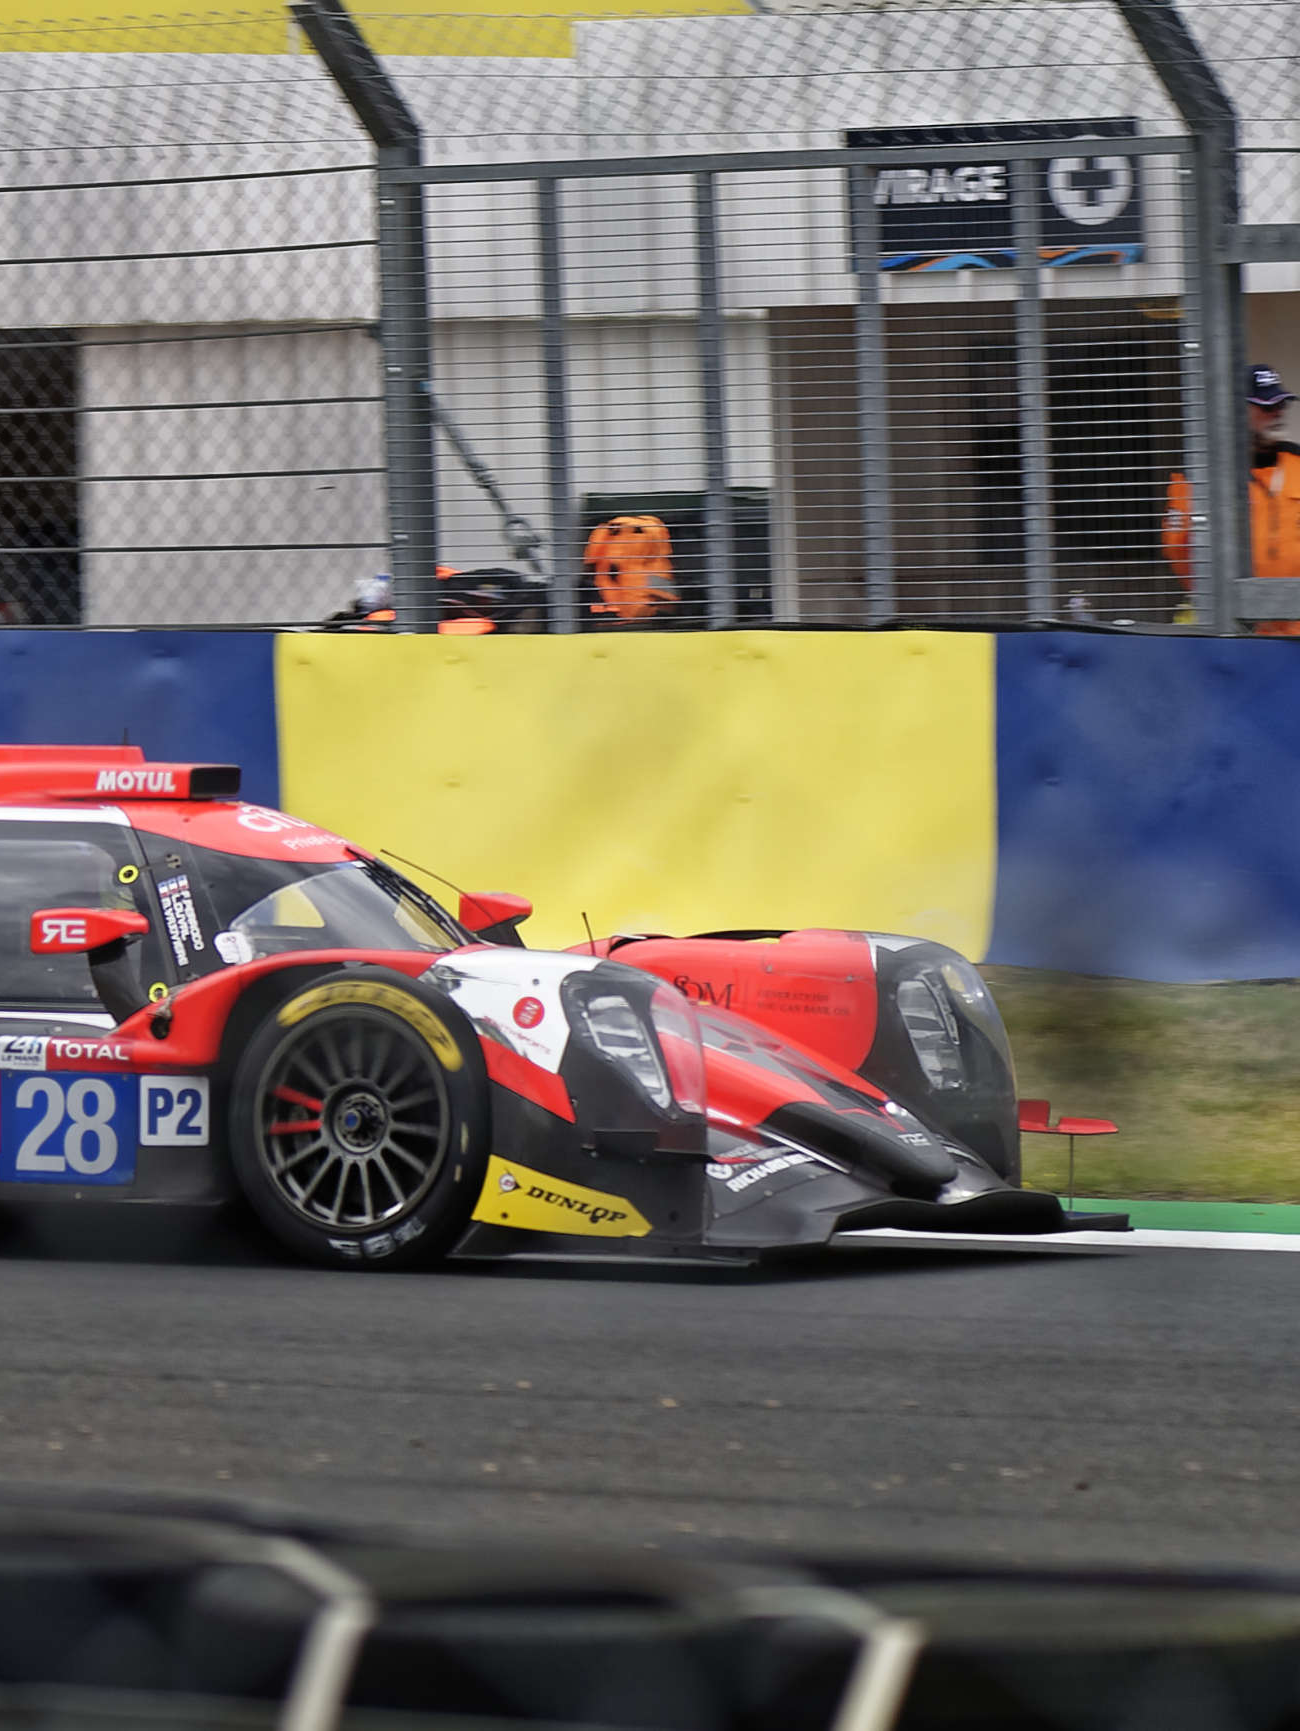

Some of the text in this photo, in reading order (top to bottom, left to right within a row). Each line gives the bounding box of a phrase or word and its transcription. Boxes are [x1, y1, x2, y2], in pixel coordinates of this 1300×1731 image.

[96, 770, 177, 793] MOTUL
[51, 1039, 130, 1061] TOTAL
[15, 1076, 119, 1175] 28
[147, 1087, 203, 1136] P2
[526, 1186, 629, 1222] DUNLOP
